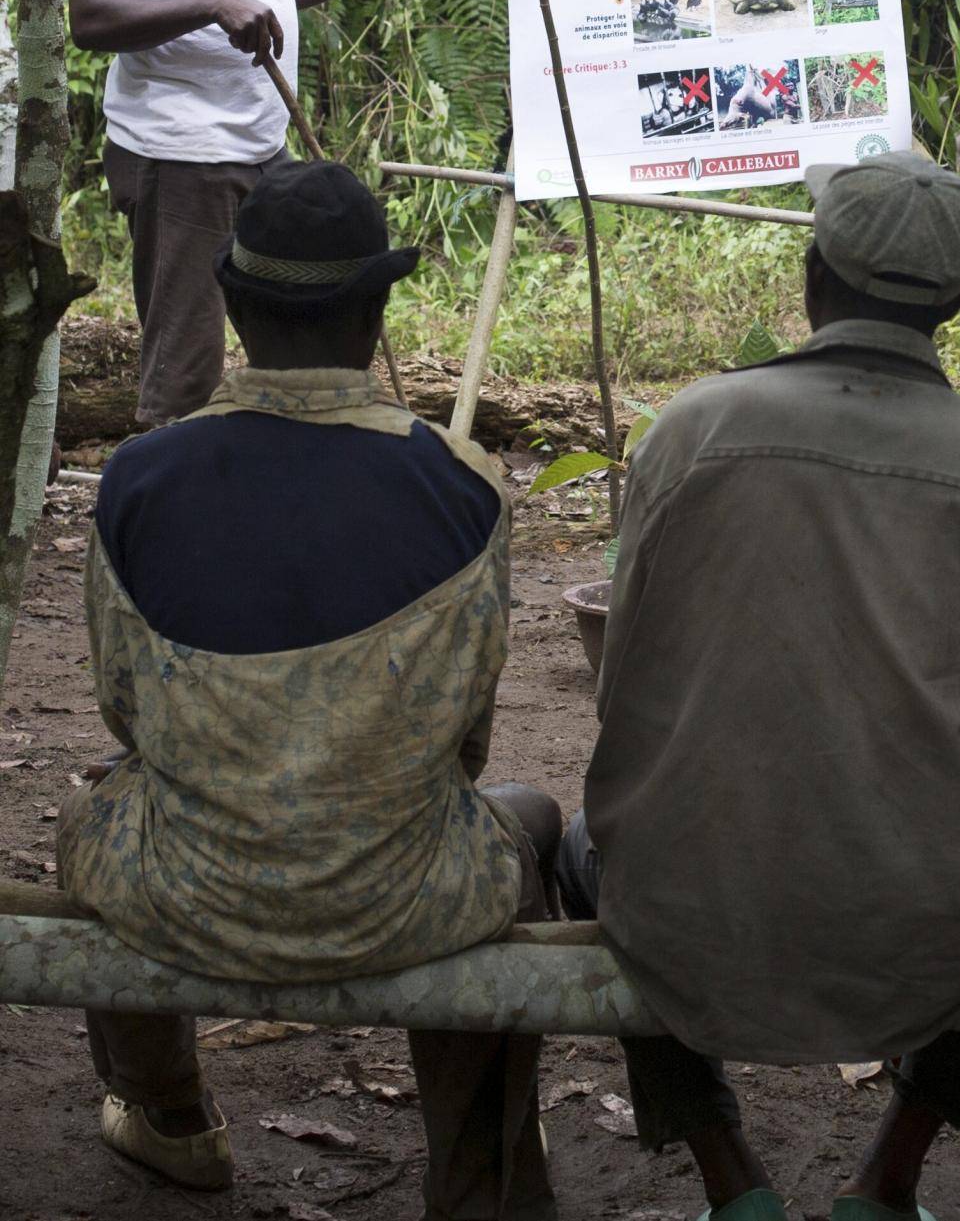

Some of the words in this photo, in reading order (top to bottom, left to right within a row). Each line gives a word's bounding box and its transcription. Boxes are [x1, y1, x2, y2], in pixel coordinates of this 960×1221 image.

[575, 24, 602, 32] animaux
[613, 21, 627, 29] voie
[593, 30, 628, 40] disparition
[544, 67, 572, 76] Crre
[635, 164, 684, 180] BARRY
[706, 153, 796, 174] CALLEBAUT
